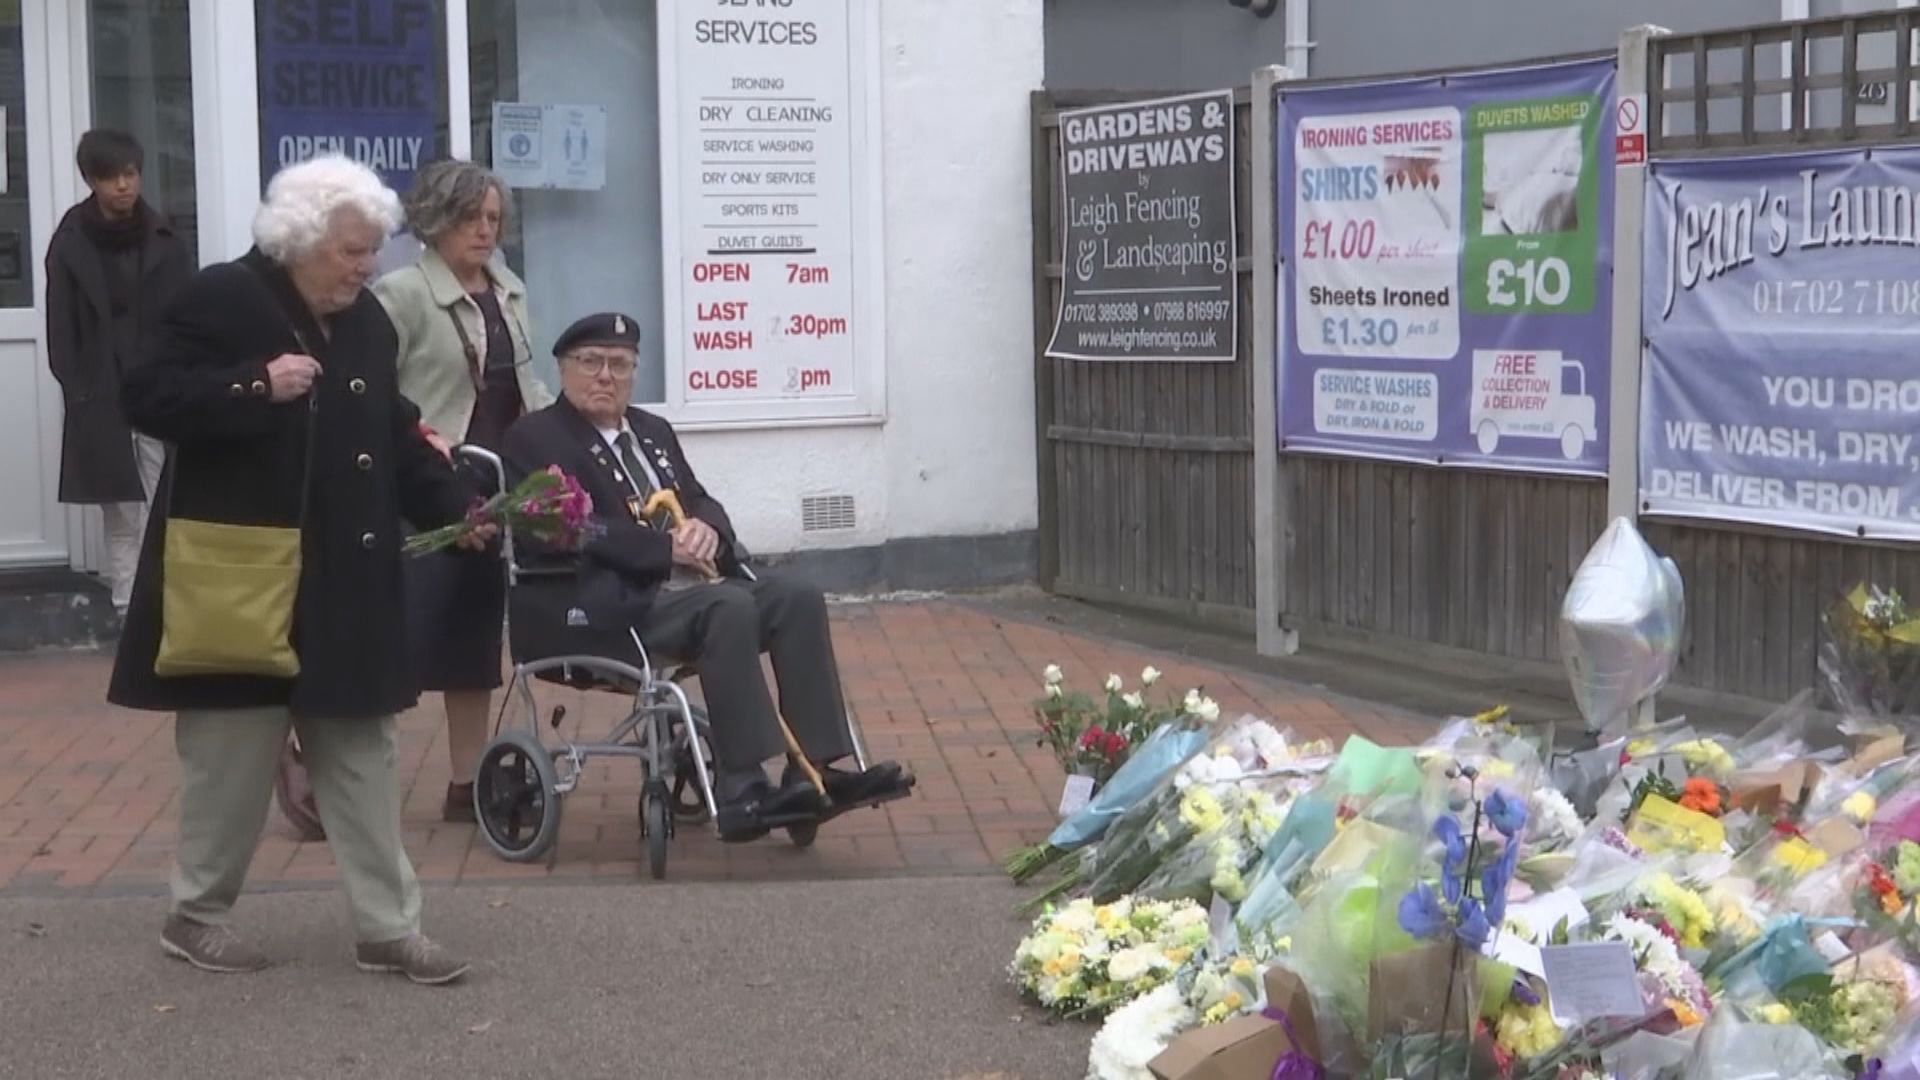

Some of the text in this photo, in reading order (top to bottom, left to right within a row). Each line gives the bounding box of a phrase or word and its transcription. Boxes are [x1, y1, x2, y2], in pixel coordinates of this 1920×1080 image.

[271, 0, 429, 45] SELF
[695, 20, 817, 44] SERVICES
[274, 60, 425, 108] SERVICE
[732, 78, 784, 90] IRONING
[700, 106, 832, 122] DRY CLEANING
[1066, 102, 1225, 143] GARDENS &
[1477, 102, 1589, 128] DUVETS WASHED
[703, 140, 813, 153] SERVICE WASHING
[1302, 120, 1453, 149] IRONING SERVICES
[354, 136, 422, 171] DAILY
[1068, 135, 1224, 174] DRIVEWAYS
[702, 172, 815, 184] DRY ONLY SERVICE
[1138, 170, 1150, 188] by
[1302, 165, 1378, 201] SHIRTS
[721, 204, 799, 216] SPORTS KITS
[1071, 189, 1201, 235] Leigh Fencing
[718, 236, 803, 249] DUVET QUILTS
[1303, 219, 1376, 260] £1.00
[1661, 181, 1789, 321] Jean's
[1076, 234, 1227, 281] & Landscaping
[693, 263, 829, 283] OPEN 7am
[1487, 256, 1570, 306] £10
[1310, 286, 1449, 306] Sheets Ironed
[1753, 280, 1843, 315] 01702
[697, 302, 748, 321] LAST
[1064, 304, 1095, 322] 01702
[693, 331, 753, 350] WASH
[1078, 326, 1217, 351] www.leighfencing.co.uk
[1322, 317, 1399, 346] £1.30
[1494, 354, 1537, 375] FREE
[689, 369, 757, 390] CLOSE
[1320, 374, 1431, 398] SERVICE WASHES
[1481, 377, 1551, 393] COLLECTION
[1492, 395, 1547, 411] DELIVERY
[1762, 376, 1834, 409] YOU
[1335, 398, 1356, 411] DRY
[1359, 399, 1368, 412] &
[1351, 415, 1379, 430] IRON
[1665, 420, 1919, 472] WE WASH, DRY,
[1651, 469, 1785, 508] DELIVER
[1796, 480, 1900, 518] FROM
